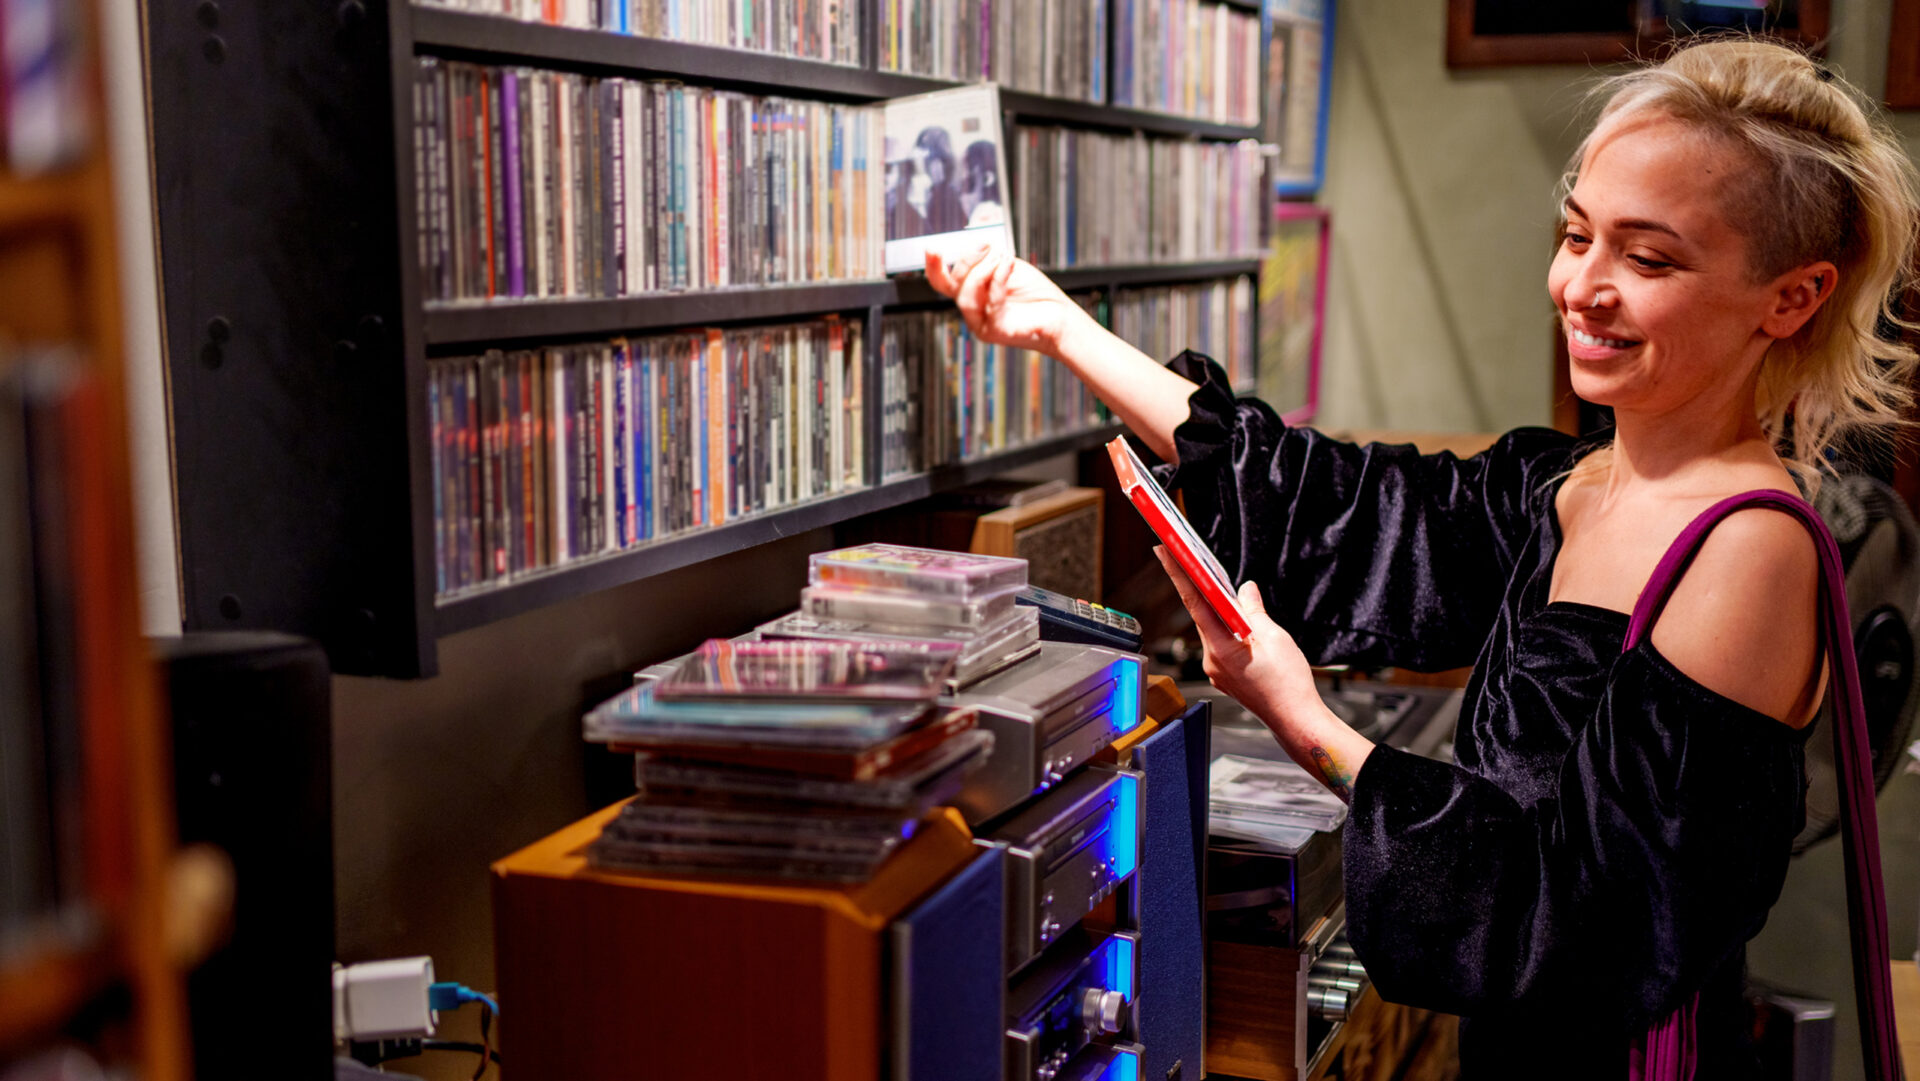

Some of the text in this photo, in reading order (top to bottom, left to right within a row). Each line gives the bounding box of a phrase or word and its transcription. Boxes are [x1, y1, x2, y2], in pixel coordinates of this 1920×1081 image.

[613, 117, 626, 256] ROGER WATERS THE WALL
